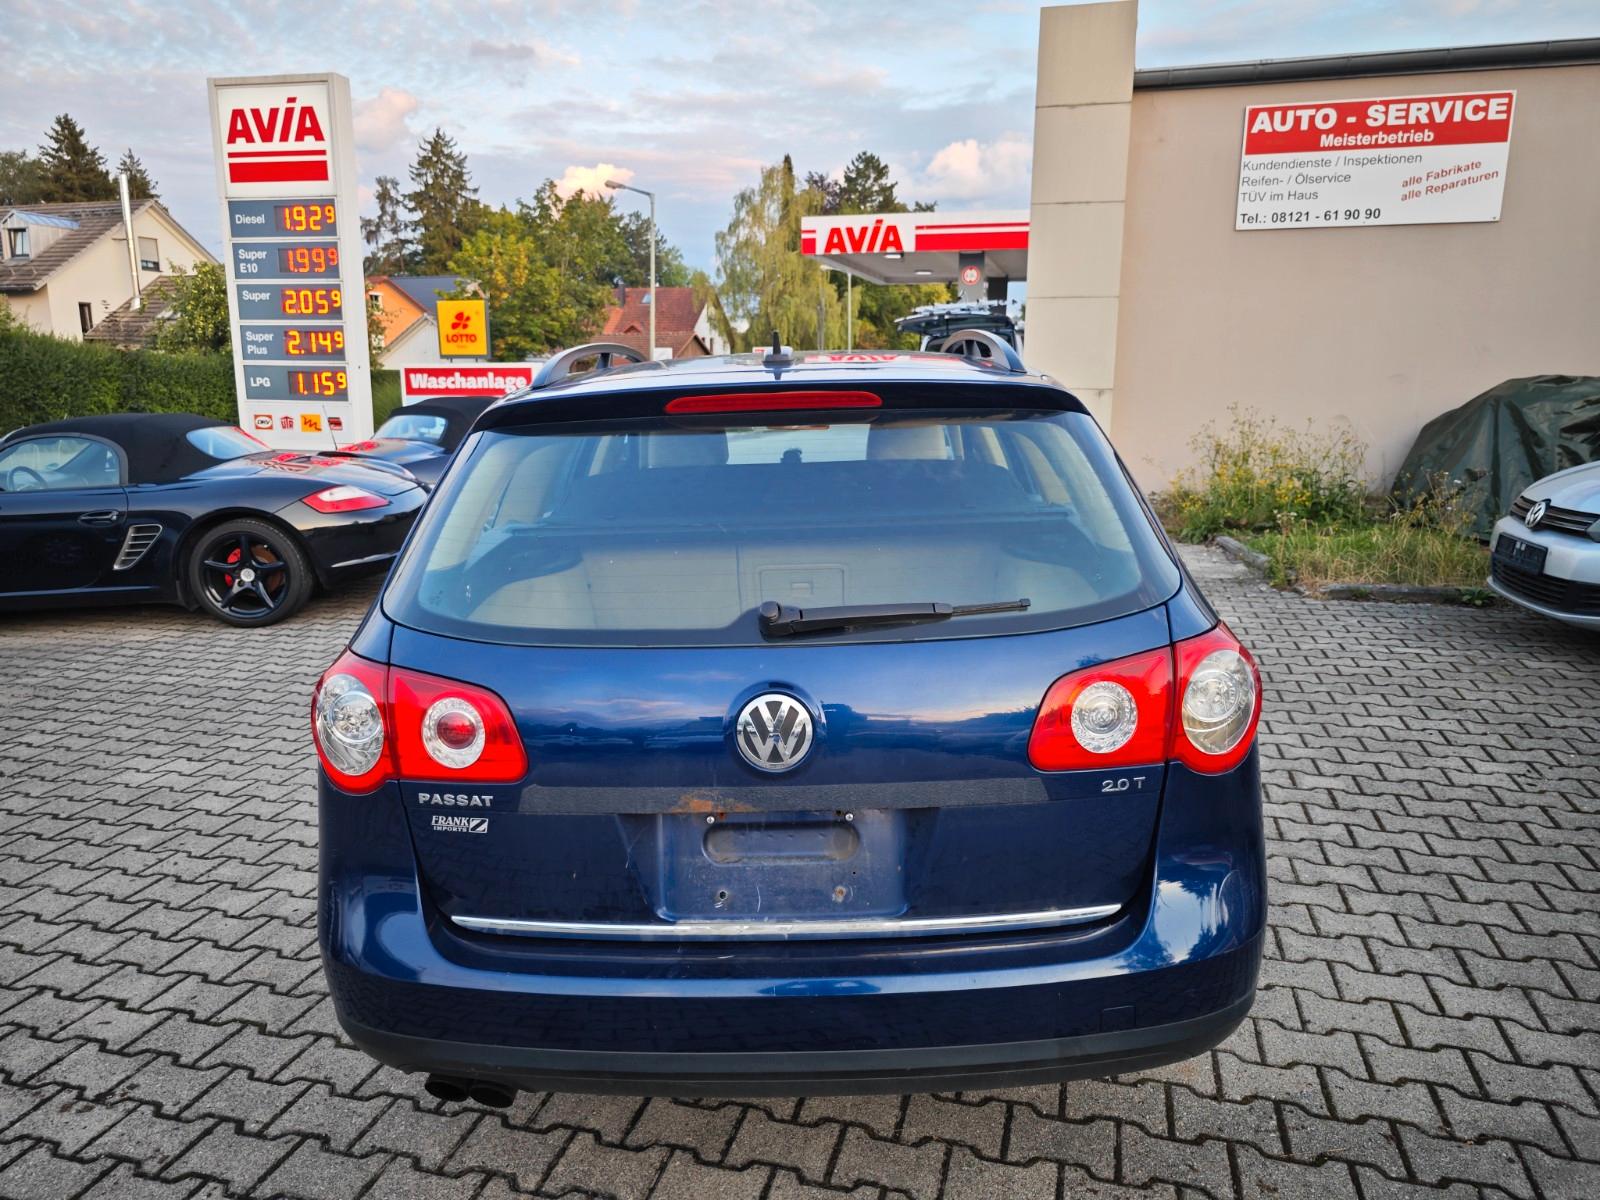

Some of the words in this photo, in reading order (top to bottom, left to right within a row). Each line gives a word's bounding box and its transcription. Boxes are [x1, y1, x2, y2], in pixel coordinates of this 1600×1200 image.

[1250, 107, 1338, 134] AUTO
[1365, 97, 1509, 127] SERVICE
[1320, 129, 1435, 148] Meisterbetrieb
[1242, 158, 1332, 172] Kundendienste
[1343, 154, 1423, 168] Inspektionen
[1241, 175, 1284, 187] Reifen-
[1295, 172, 1352, 185] Ölservice
[1402, 176, 1423, 188] alle
[1426, 161, 1482, 182] Fabrikate
[1401, 190, 1422, 202] alle
[1425, 170, 1500, 195] Reparaturen
[1240, 190, 1267, 203] TÜV
[1269, 191, 1284, 202] im
[1287, 190, 1319, 201] Haus
[235, 214, 265, 224] Diesel
[1240, 213, 1267, 224] Tel.:
[1271, 210, 1310, 223] 08121
[1323, 209, 1339, 221] 61
[1344, 208, 1360, 220] 90
[1364, 207, 1381, 219] 90
[238, 249, 267, 260] Super
[240, 263, 258, 273] E10
[242, 290, 271, 302] Super
[245, 331, 274, 343] Super
[446, 334, 477, 343] LOTTO
[247, 345, 268, 355] Plus
[250, 377, 271, 387] LPG
[409, 372, 528, 393] Waschanlage
[1133, 776, 1146, 789] T
[418, 792, 494, 807] PASSAT
[431, 815, 470, 827] FRANK
